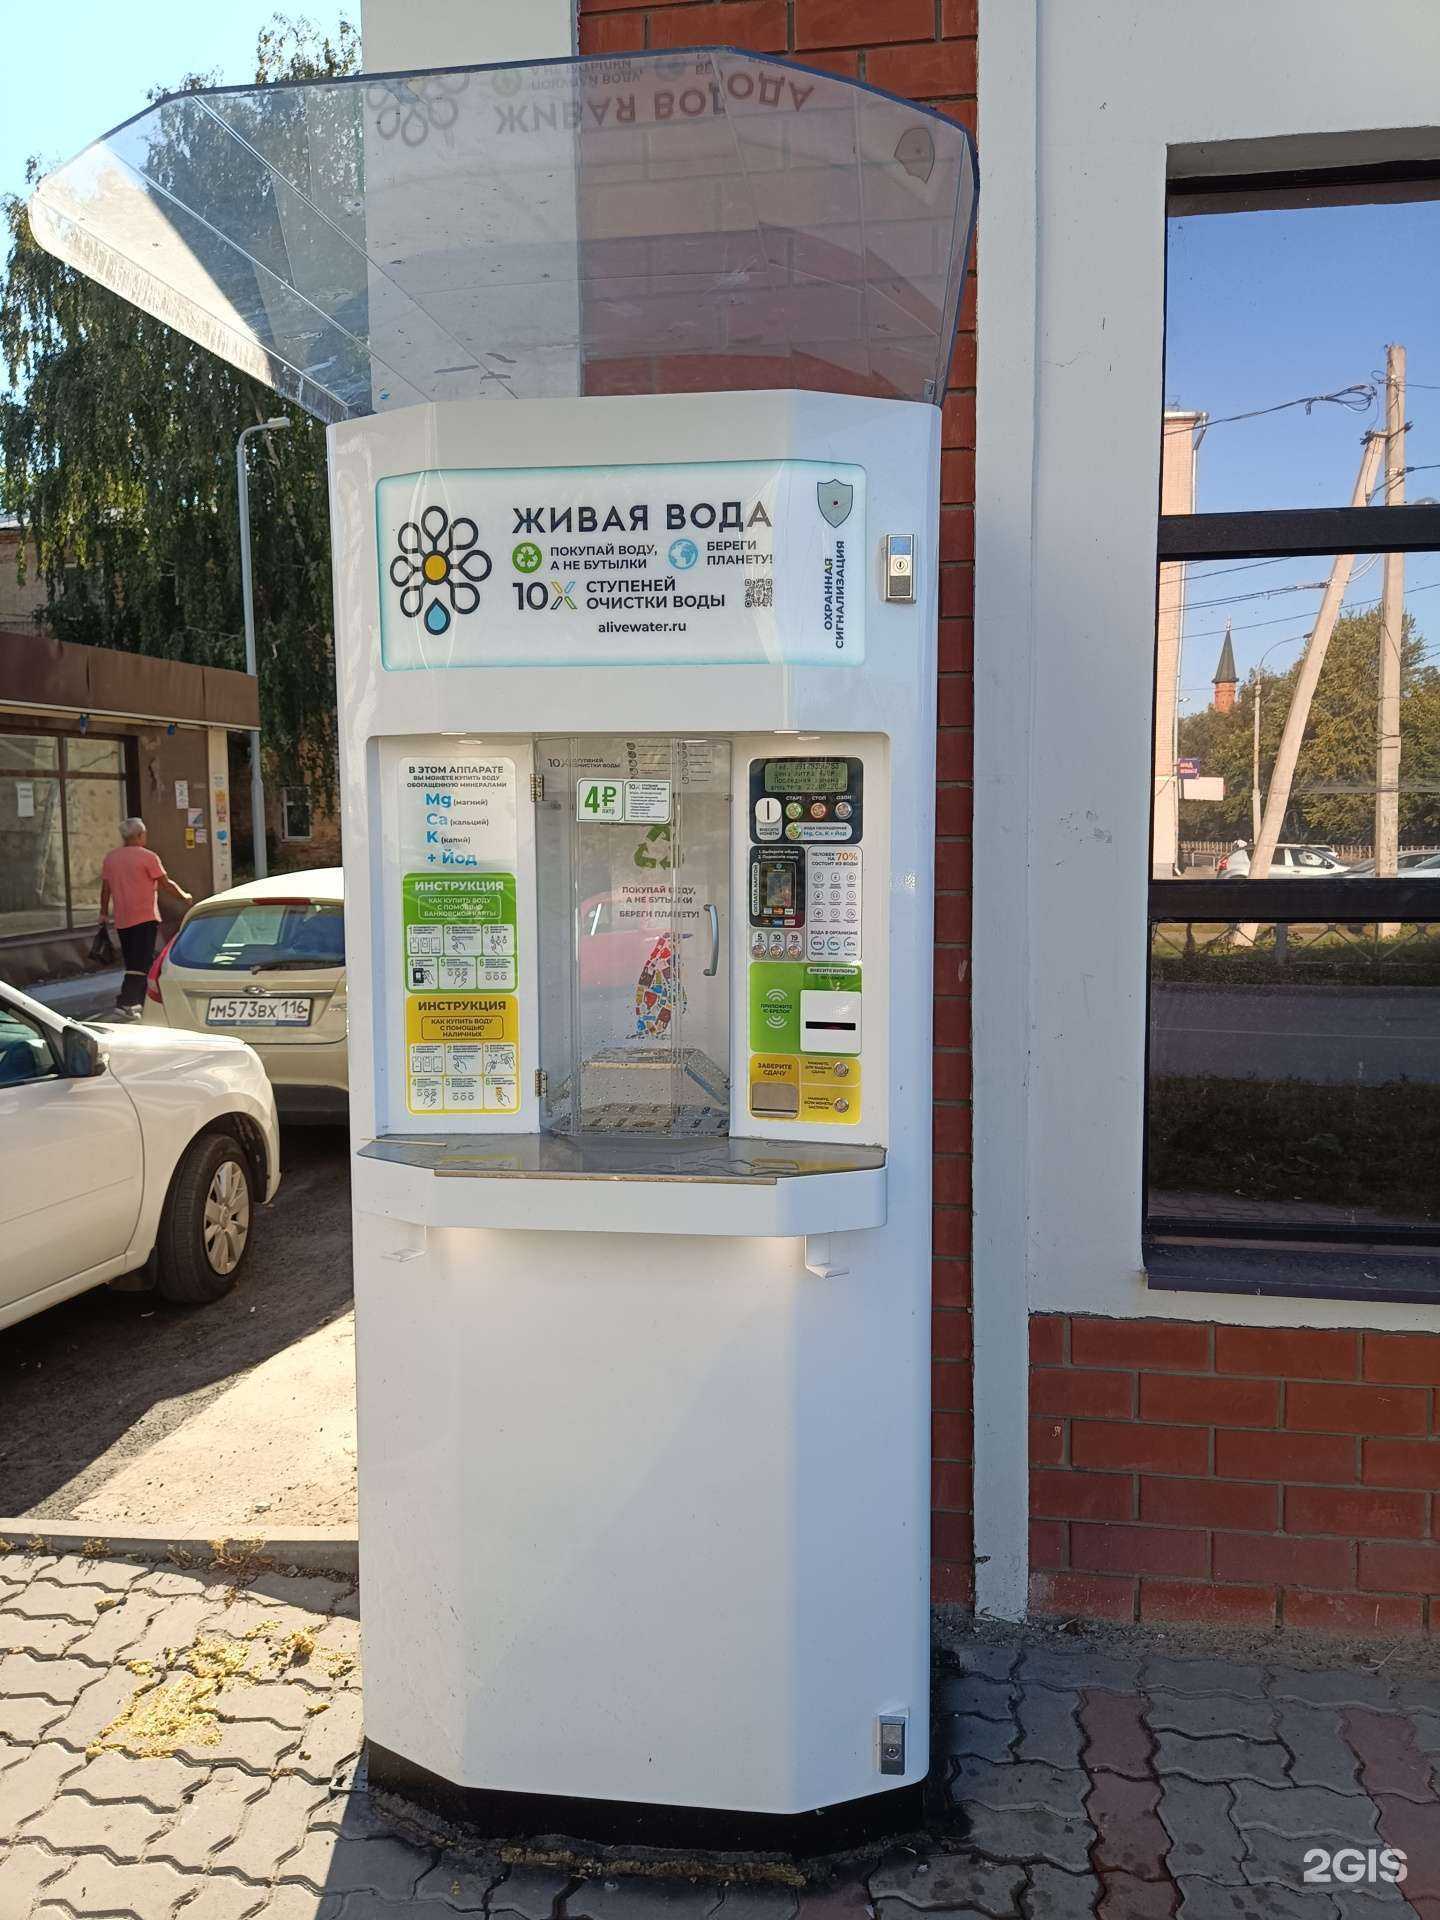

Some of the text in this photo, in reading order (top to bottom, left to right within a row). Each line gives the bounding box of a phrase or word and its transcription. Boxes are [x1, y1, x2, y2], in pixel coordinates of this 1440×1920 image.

[512, 500, 773, 534] ЖИВАЯ ВОДА
[550, 544, 657, 557] ПОКУПАЙ ВОДУ,
[706, 540, 757, 551] БЕРЕГИ
[550, 558, 647, 571] А НЕ БУТЫЛКИ
[706, 554, 773, 566] ПЛАНЕТУ!
[586, 576, 676, 593] СТУПЕНЕЙ
[824, 558, 833, 631] ОХРАННАЯ
[836, 540, 845, 648] СИГНАЛИЗАЦИЯ
[586, 594, 725, 610] ОЧИСТКИ ВОДЫ
[598, 620, 687, 633] alivewater.ru
[408, 766, 503, 774] В ЭТОМ АППАРАТЕ
[425, 793, 451, 808] Mg
[426, 813, 448, 826] Ca
[426, 831, 438, 843] K
[441, 849, 478, 866] Йод
[836, 852, 858, 861] 70%
[415, 881, 504, 892] ИНСТРУКЦИЯ
[622, 886, 666, 894] ПОКУПАЙ
[281, 1001, 305, 1014] 116
[418, 1001, 507, 1012] ИНСТРУКЦИЯ
